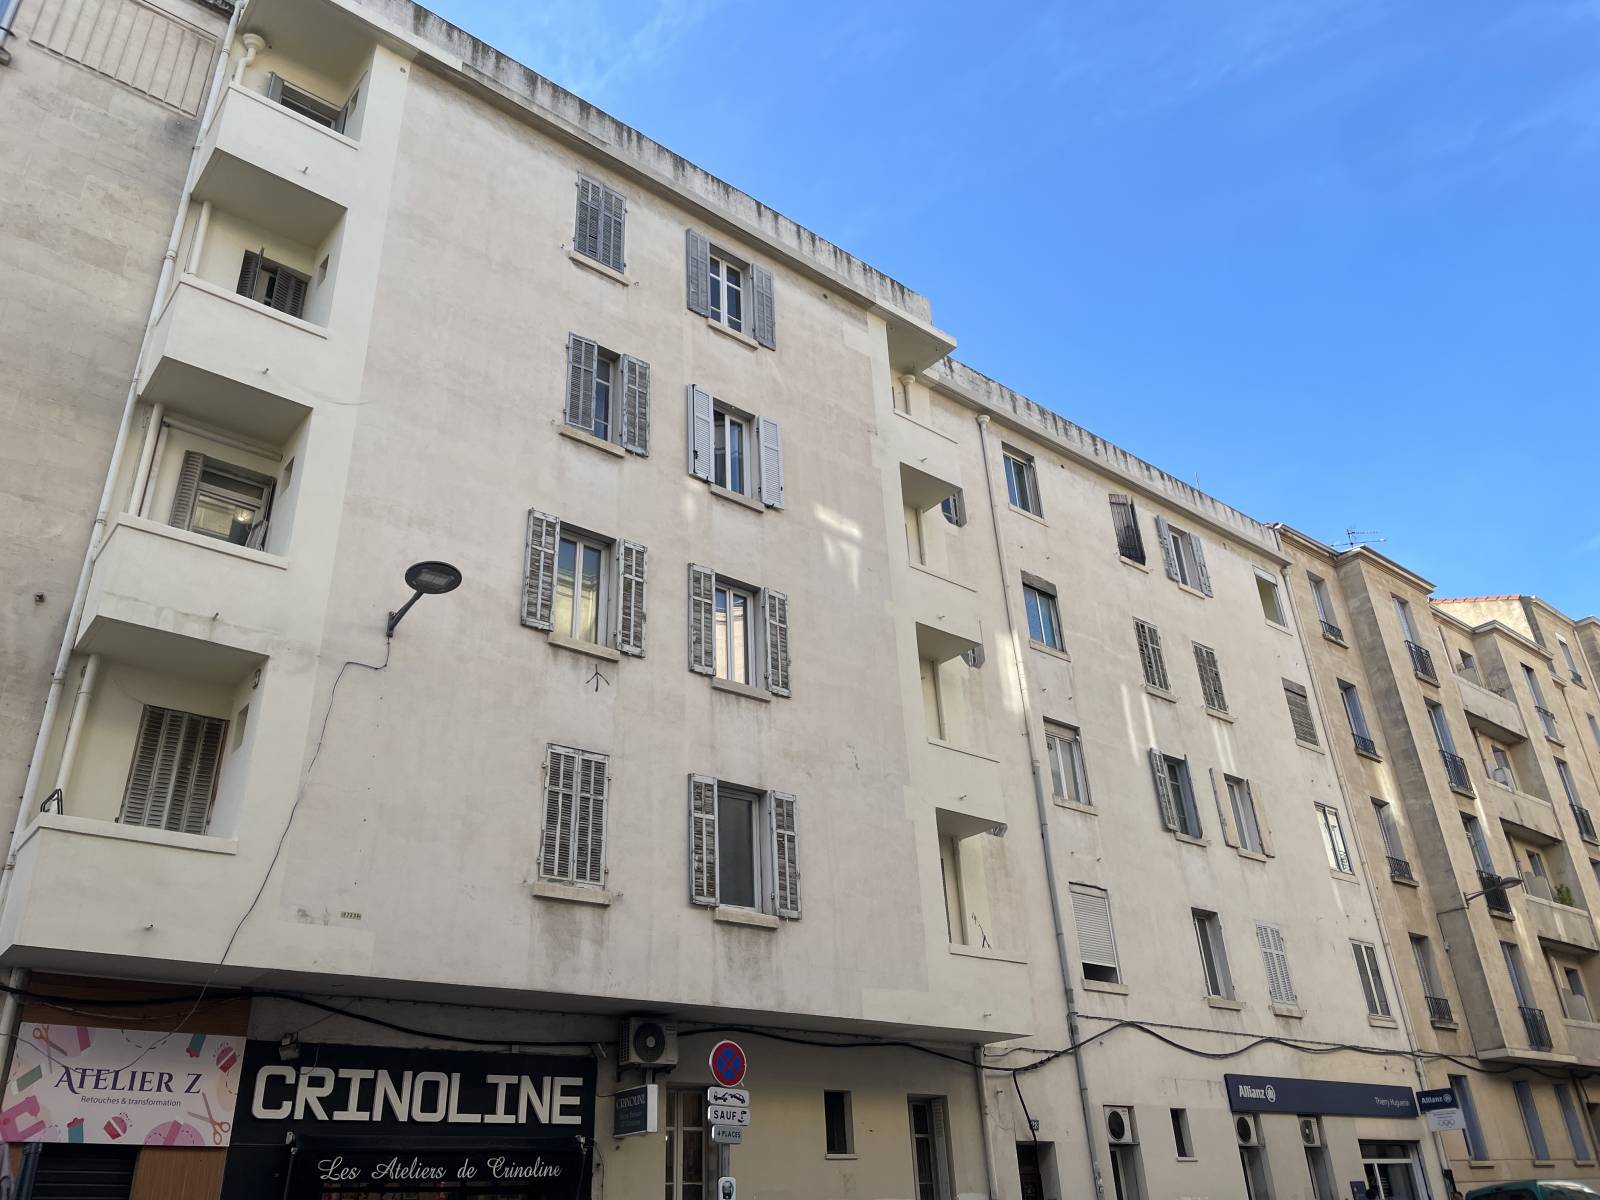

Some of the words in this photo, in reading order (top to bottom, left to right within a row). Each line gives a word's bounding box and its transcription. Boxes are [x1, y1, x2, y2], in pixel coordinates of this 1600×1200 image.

[54, 1066, 174, 1095] ATELIER
[184, 1073, 203, 1094] Z
[251, 1064, 584, 1125] CRINOLINE
[1239, 1084, 1266, 1099] Allianz
[80, 1095, 120, 1105] Retouches
[121, 1097, 127, 1105] &
[128, 1098, 182, 1107] transformation
[1421, 1096, 1443, 1106] Allianz
[713, 1110, 737, 1120] SAUF
[721, 1130, 741, 1138] PLACES
[317, 1156, 362, 1180] Les
[371, 1156, 448, 1180] Ateliers
[457, 1158, 478, 1178] de
[487, 1156, 562, 1178] Crinoline
